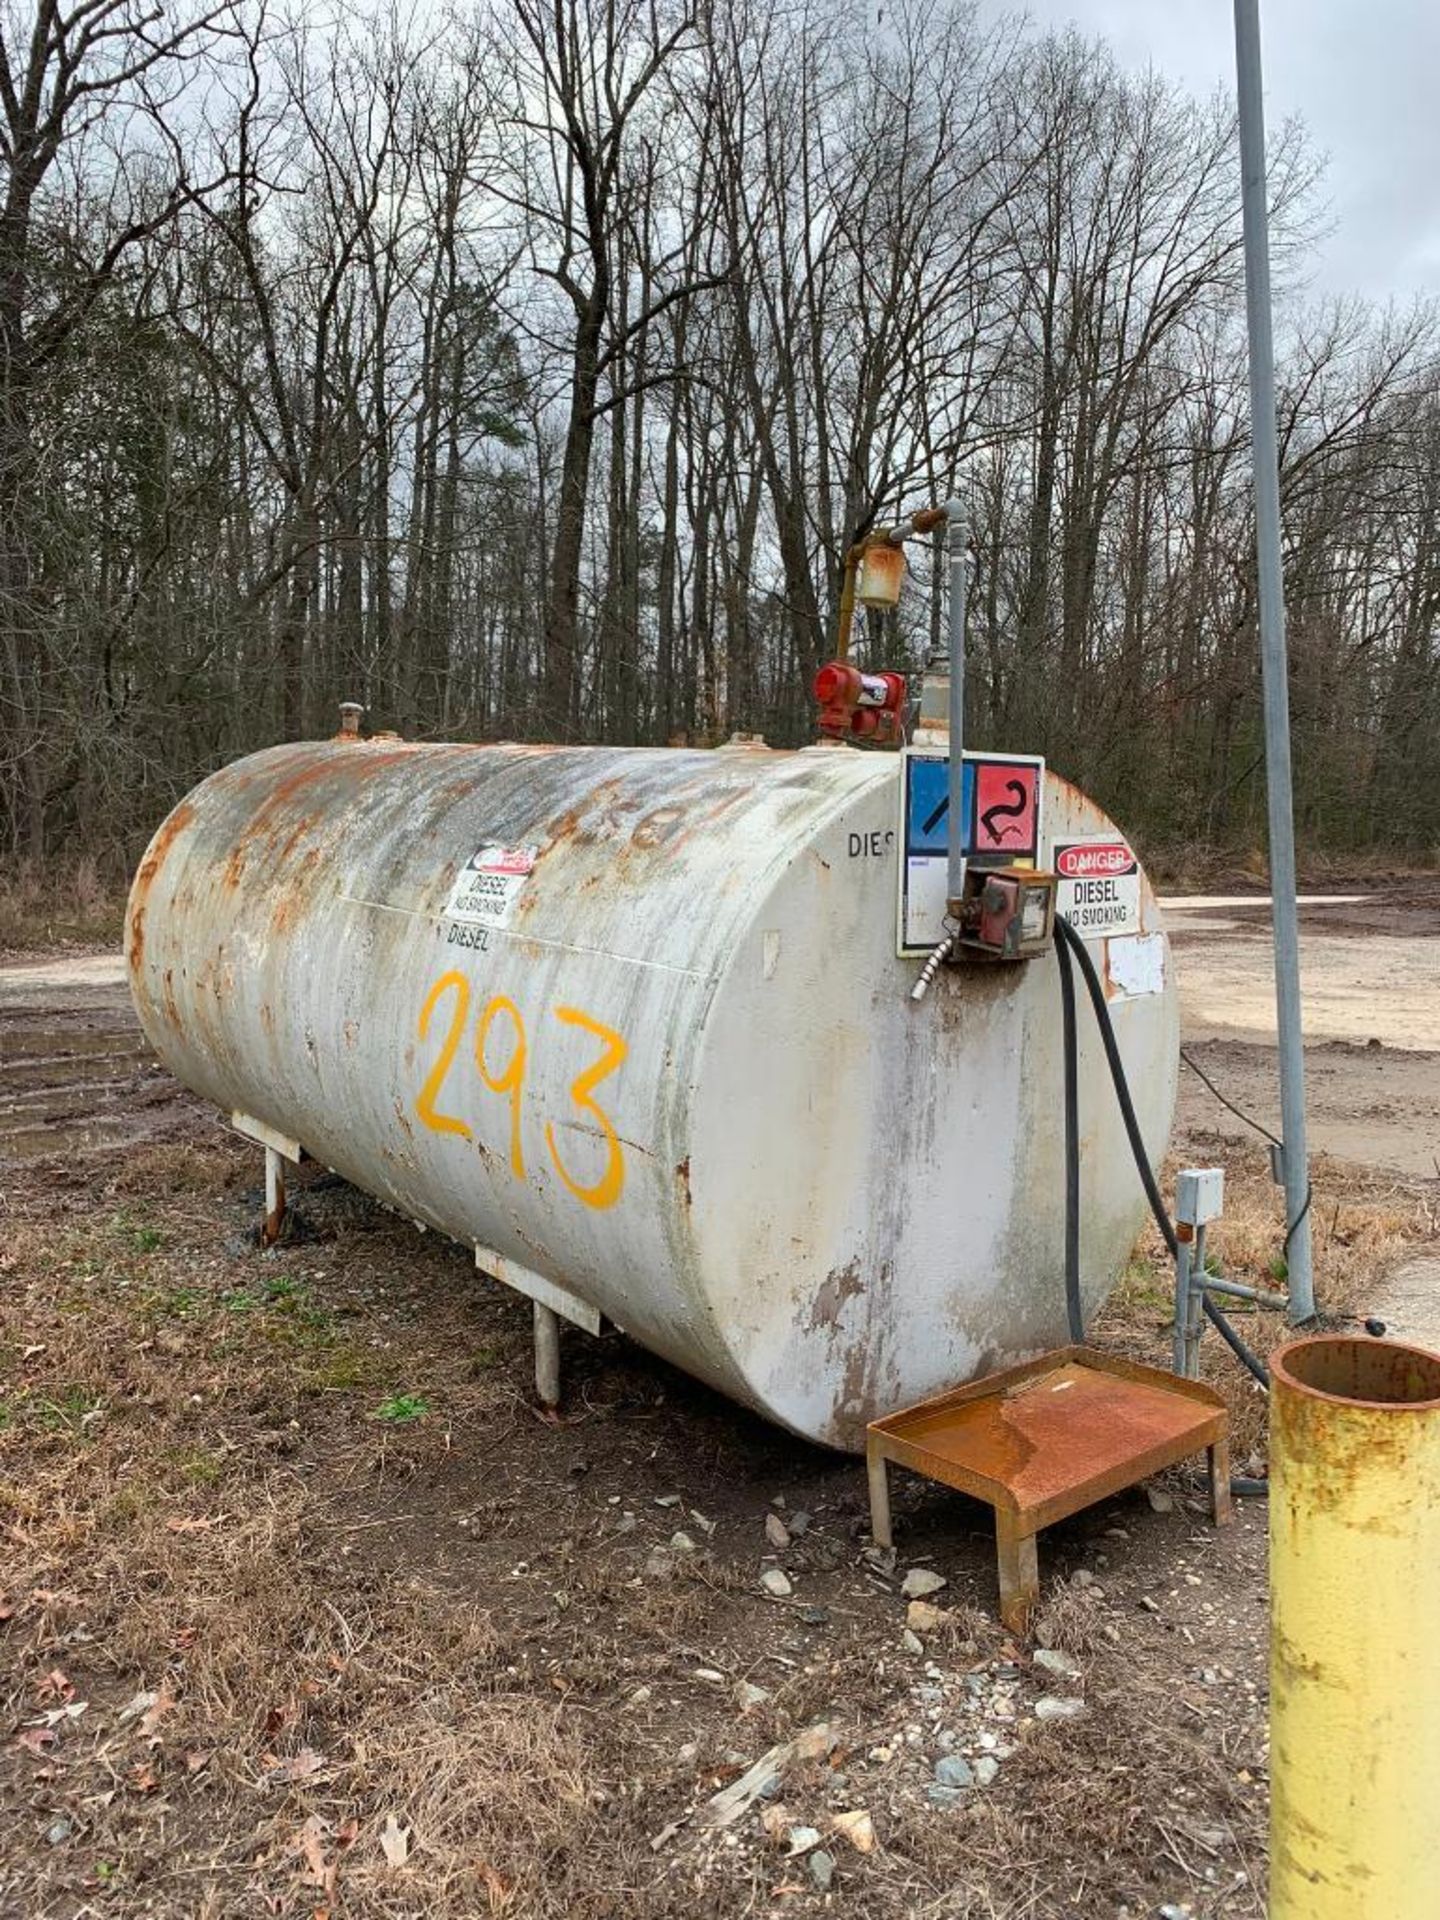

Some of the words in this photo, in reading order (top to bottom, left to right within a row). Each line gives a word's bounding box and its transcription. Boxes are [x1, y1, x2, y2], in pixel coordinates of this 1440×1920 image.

[1066, 851, 1126, 873] DANGER
[470, 874, 509, 896] DIESEL
[1074, 880, 1119, 905] DIESEL
[1065, 910, 1079, 927] NO
[1082, 905, 1126, 926] SMOKING
[447, 923, 489, 952] DIESEL
[415, 969, 629, 1211] 293
